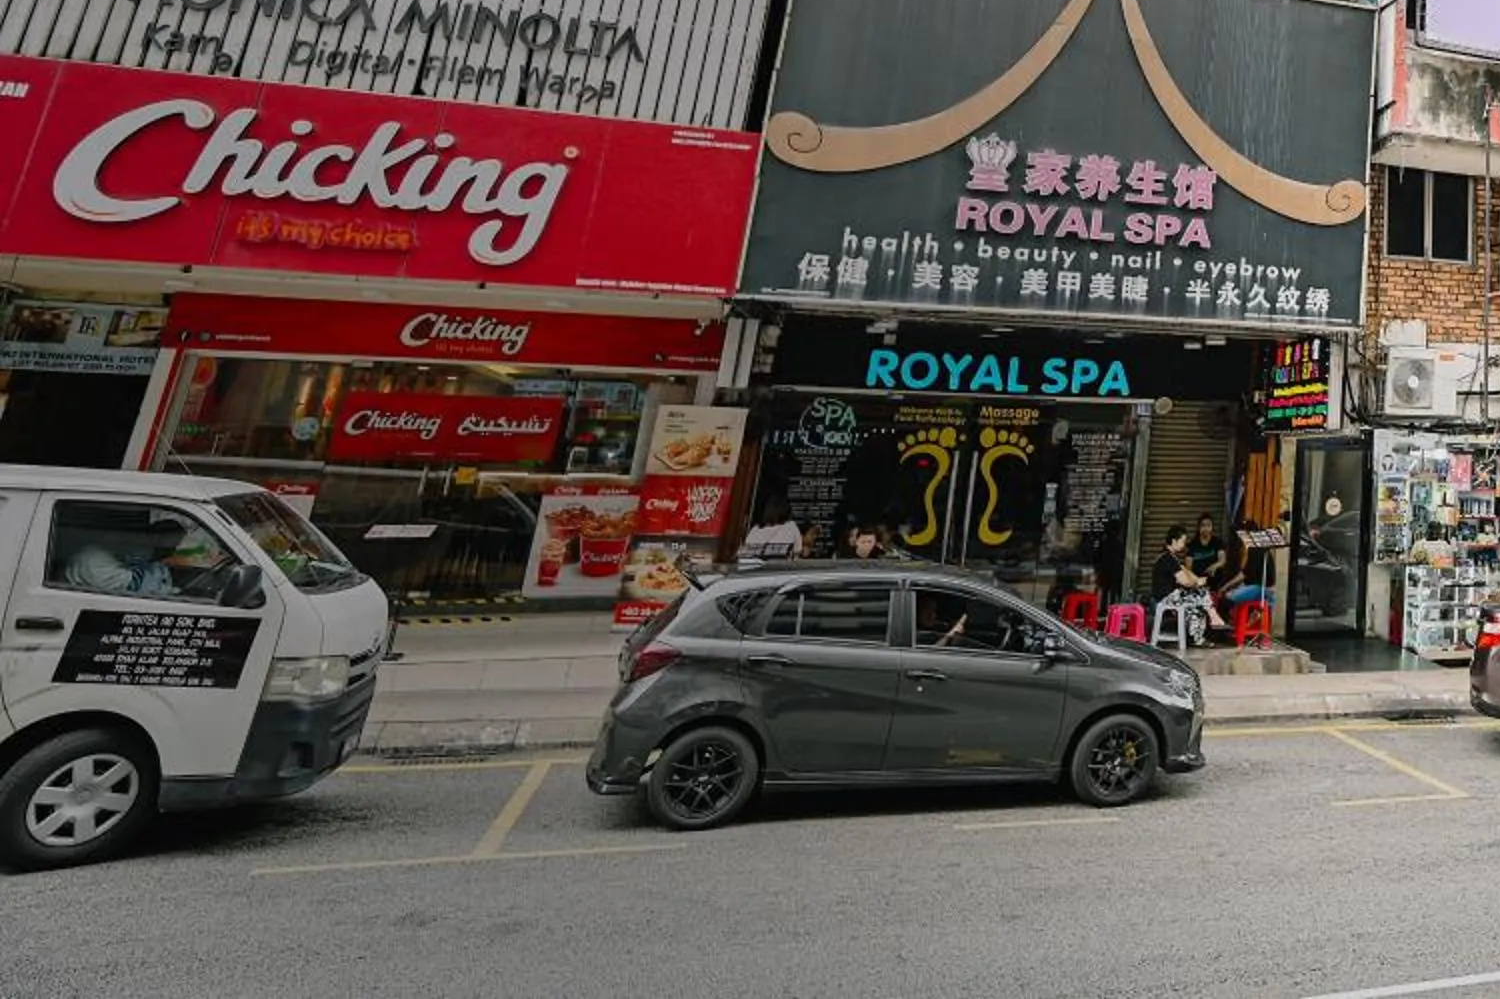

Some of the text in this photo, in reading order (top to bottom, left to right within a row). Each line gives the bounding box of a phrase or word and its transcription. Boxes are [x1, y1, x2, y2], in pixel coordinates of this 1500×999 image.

[289, 39, 400, 77] Digital
[52, 99, 573, 266] Chicking
[965, 132, 1218, 210] 皇家养生馆
[281, 222, 324, 246] my
[330, 222, 411, 250] choice
[955, 196, 1212, 249] ROYAL SPA
[798, 252, 870, 285] 保健
[912, 259, 980, 292] 美容
[843, 226, 1301, 280] health beauty nail eyebrow
[400, 313, 530, 355] Chicking
[866, 348, 1130, 397] ROYAL SPA
[344, 409, 442, 441] Chicking
[811, 397, 857, 428] SPA
[980, 405, 1041, 420] Massage
